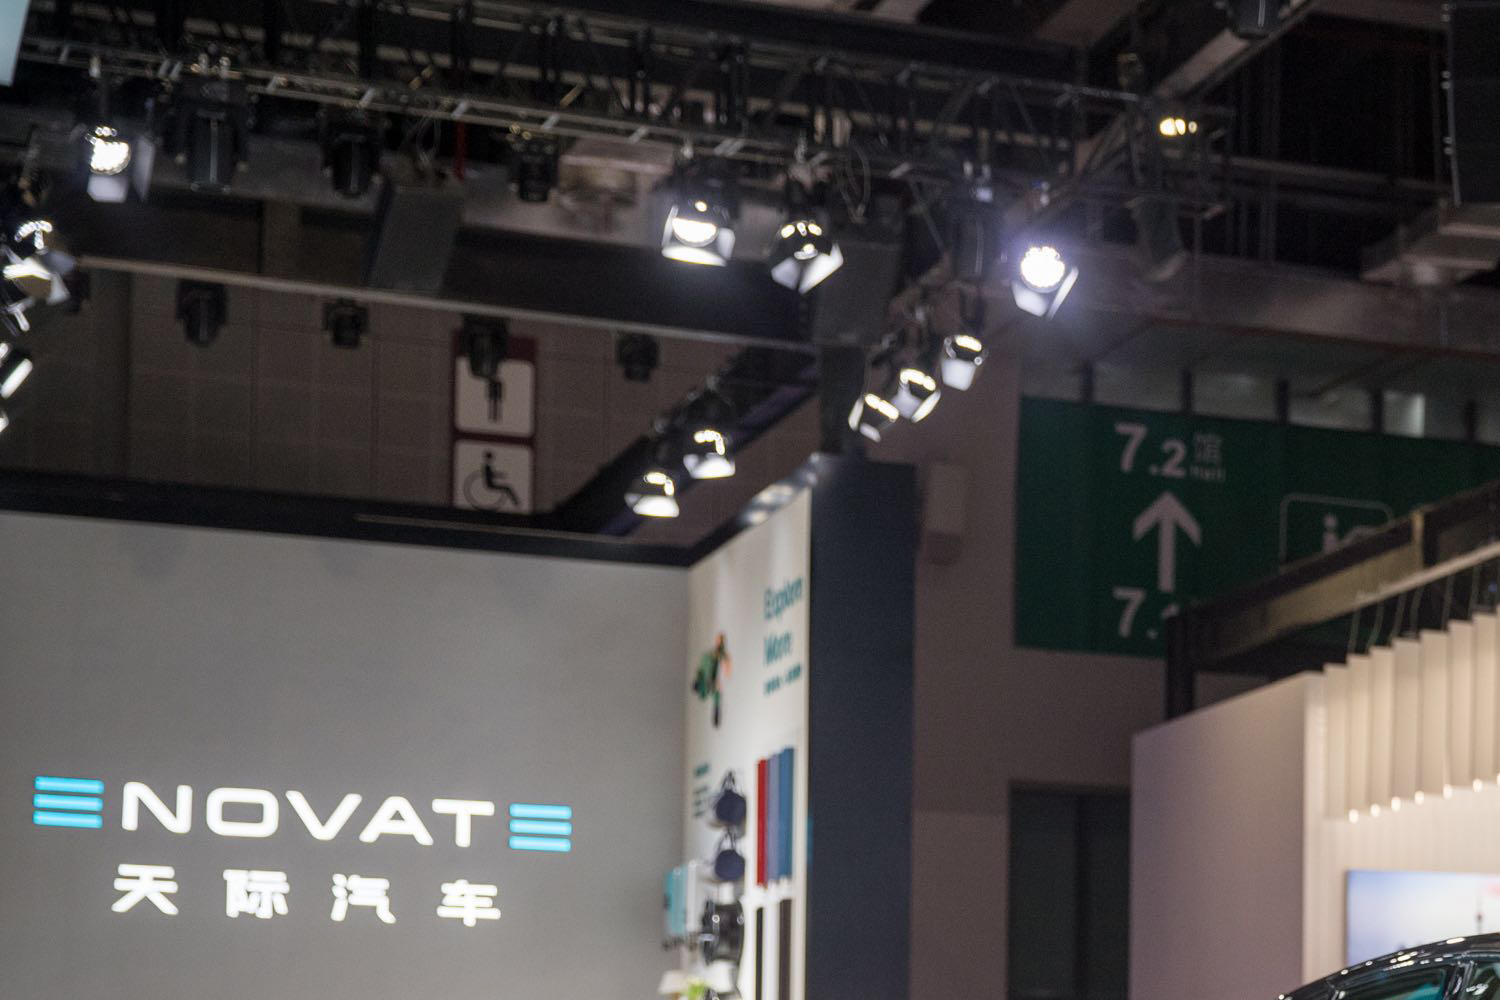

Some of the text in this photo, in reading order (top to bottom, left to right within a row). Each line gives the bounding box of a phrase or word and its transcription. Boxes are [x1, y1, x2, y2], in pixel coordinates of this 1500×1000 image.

[1114, 423, 1186, 478] 7.2
[1113, 587, 1180, 639] 7.
[33, 776, 572, 852] ENOVATE
[111, 863, 501, 926] 天际汽车
